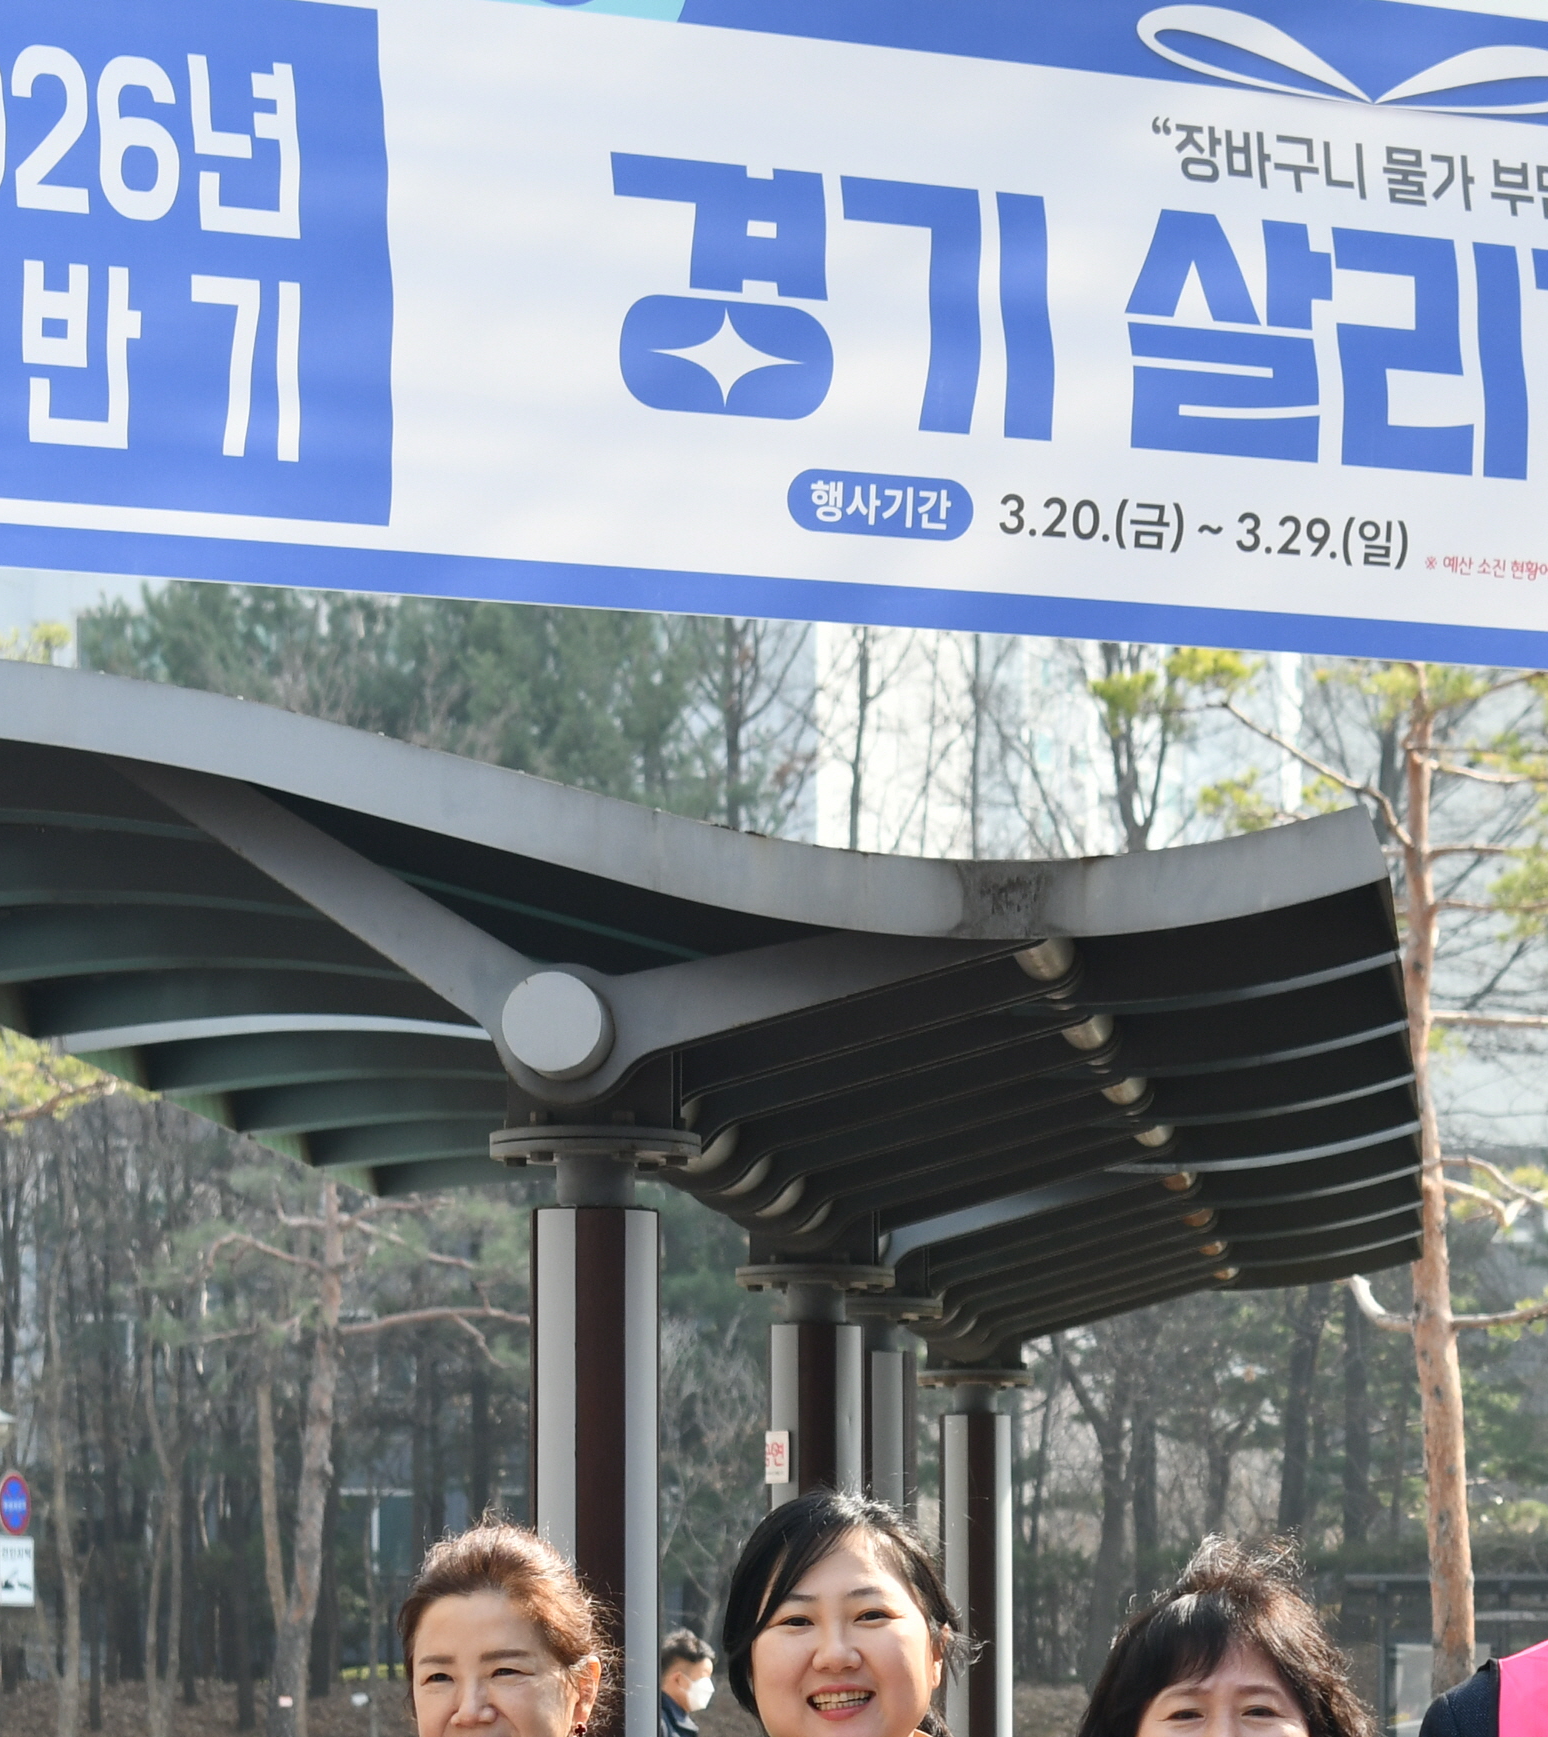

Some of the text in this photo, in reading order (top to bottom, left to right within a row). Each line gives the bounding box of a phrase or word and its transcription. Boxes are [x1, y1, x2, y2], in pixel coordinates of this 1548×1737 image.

[1151, 116, 1367, 200] “장바구니
[1382, 146, 1475, 212] 물가
[611, 152, 1055, 441] 경기
[810, 480, 952, 531] 행사기간
[999, 493, 1184, 553] 3.20.(금)
[1236, 512, 1409, 570] 3.29.(일)
[1443, 555, 1472, 575] 예산
[1477, 558, 1506, 578] 소진
